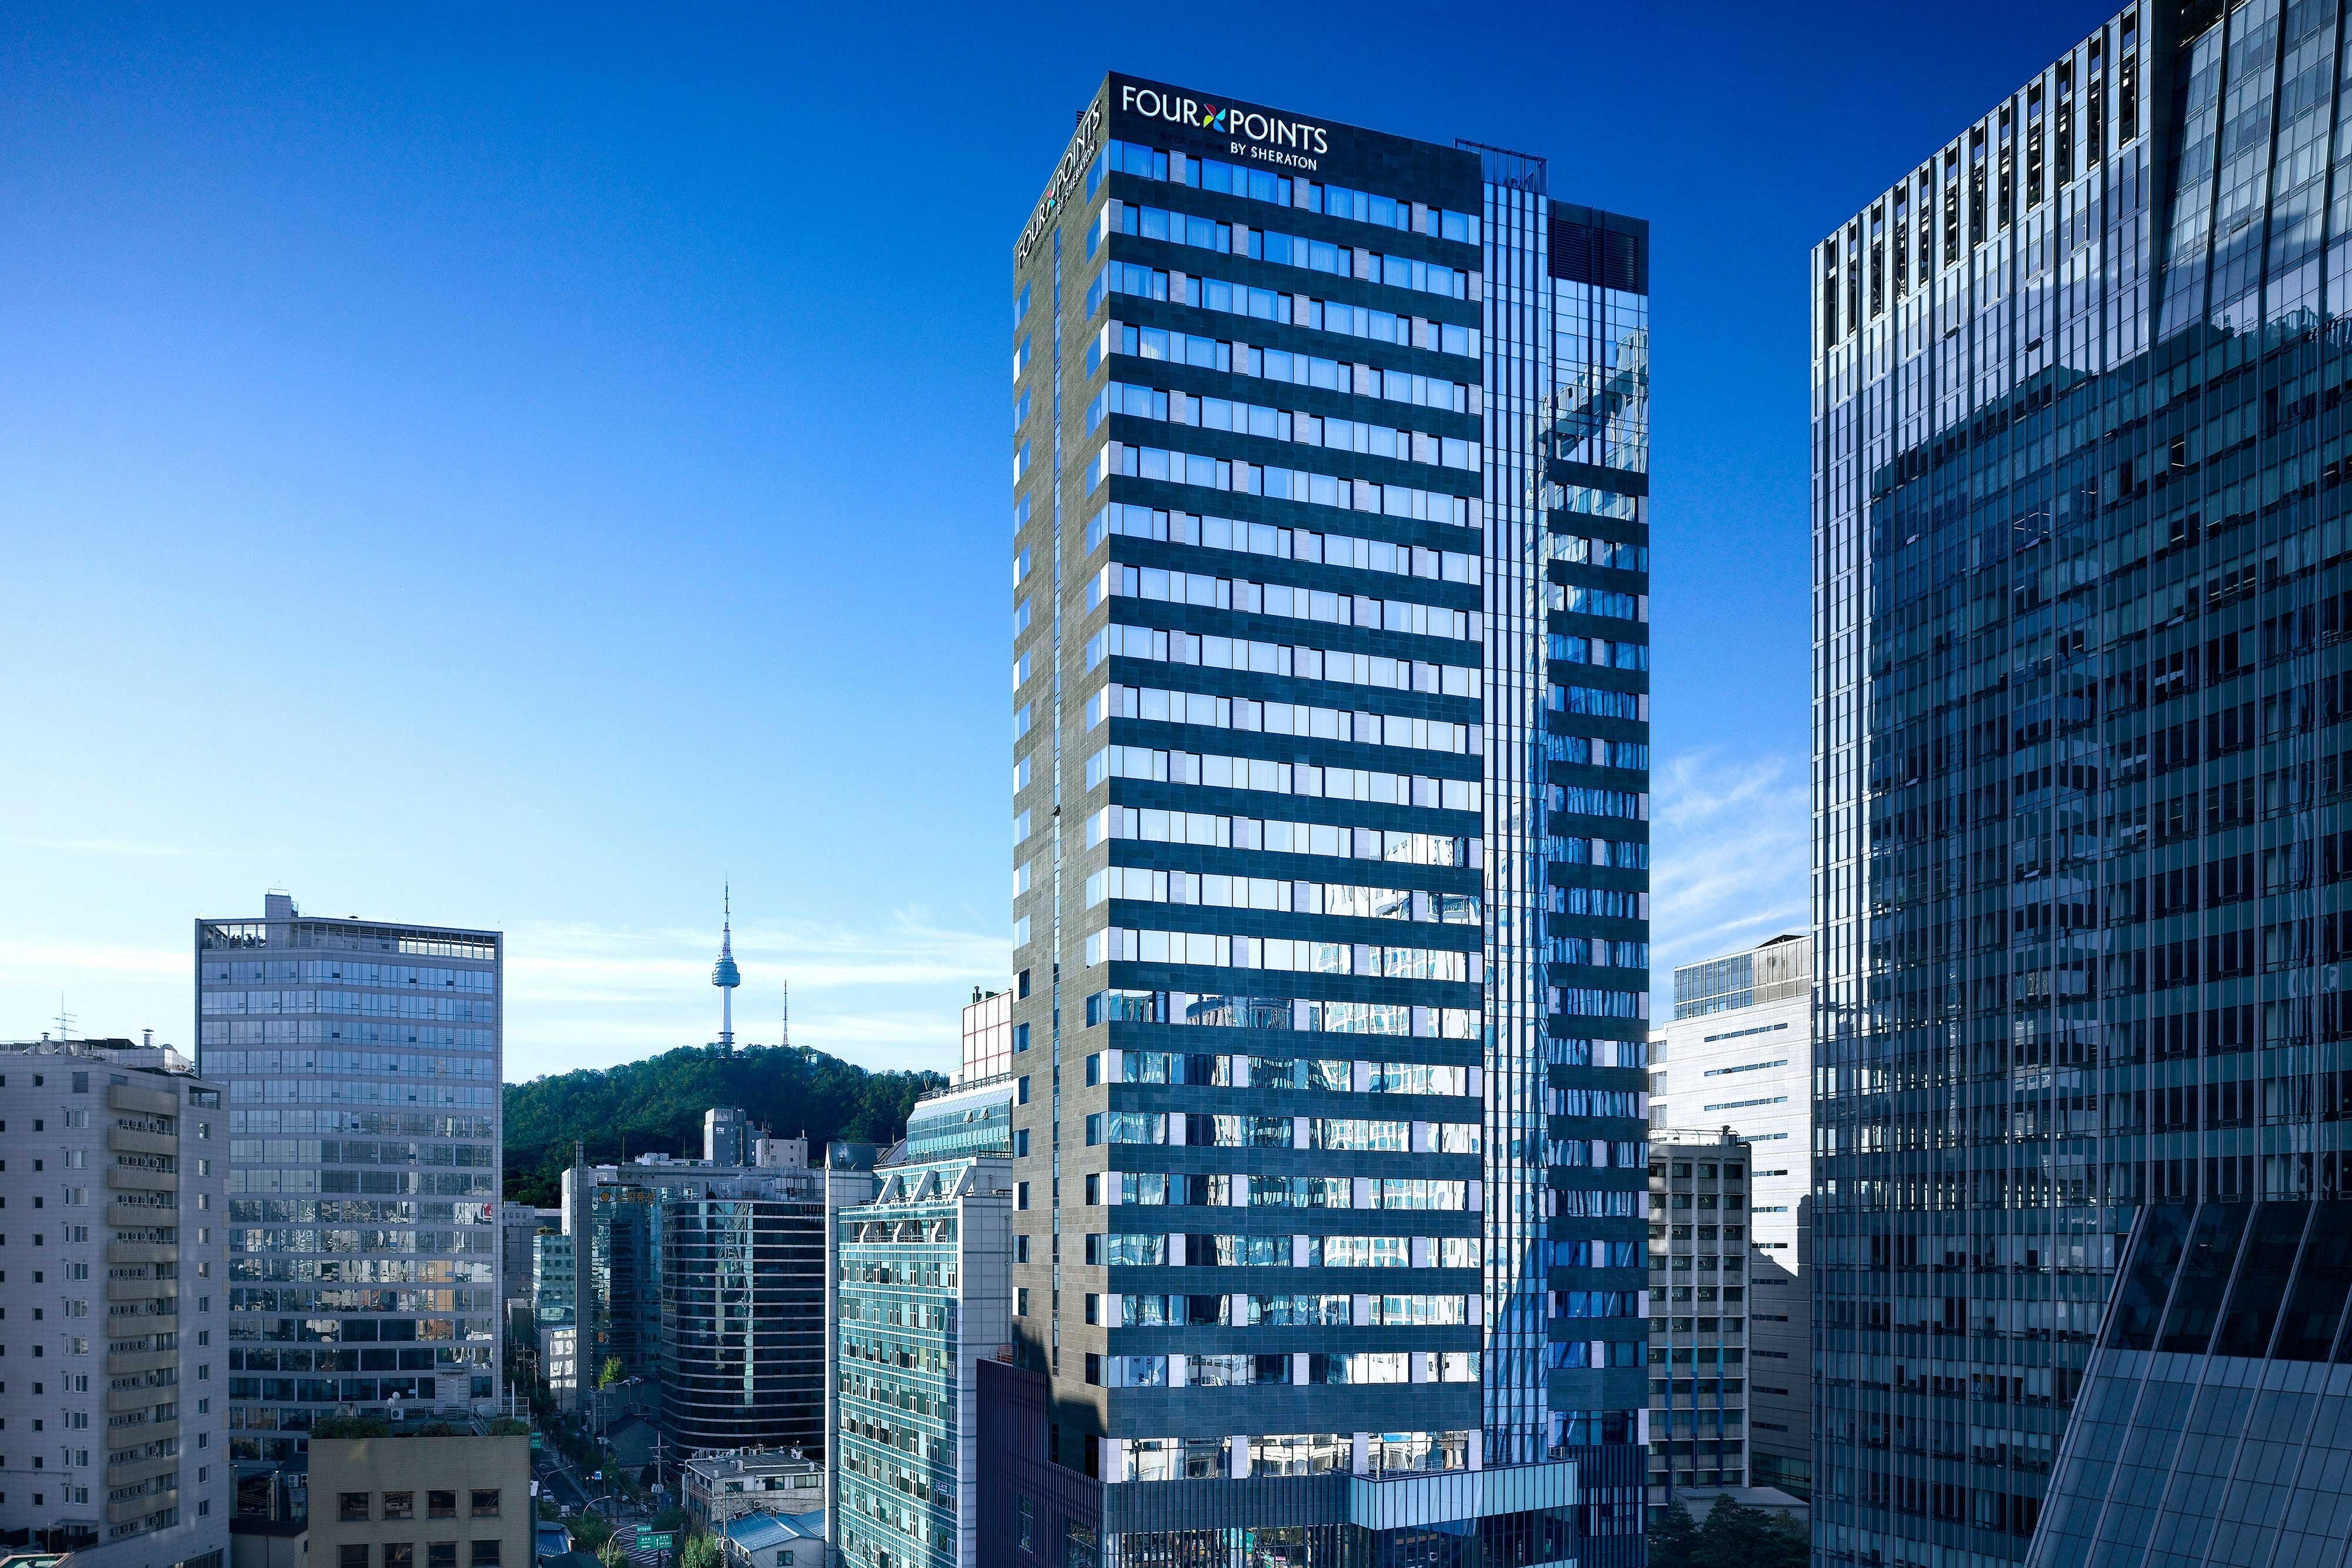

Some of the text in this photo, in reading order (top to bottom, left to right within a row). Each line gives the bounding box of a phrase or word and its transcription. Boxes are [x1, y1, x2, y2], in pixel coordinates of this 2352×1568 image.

[1122, 85, 1328, 155] FOUR POINTS
[1018, 202, 1048, 269] FOUR
[1057, 99, 1101, 198] POINTS
[1065, 140, 1095, 197] SHERATON
[1231, 142, 1247, 155] BY
[1251, 146, 1317, 171] SHERATON
